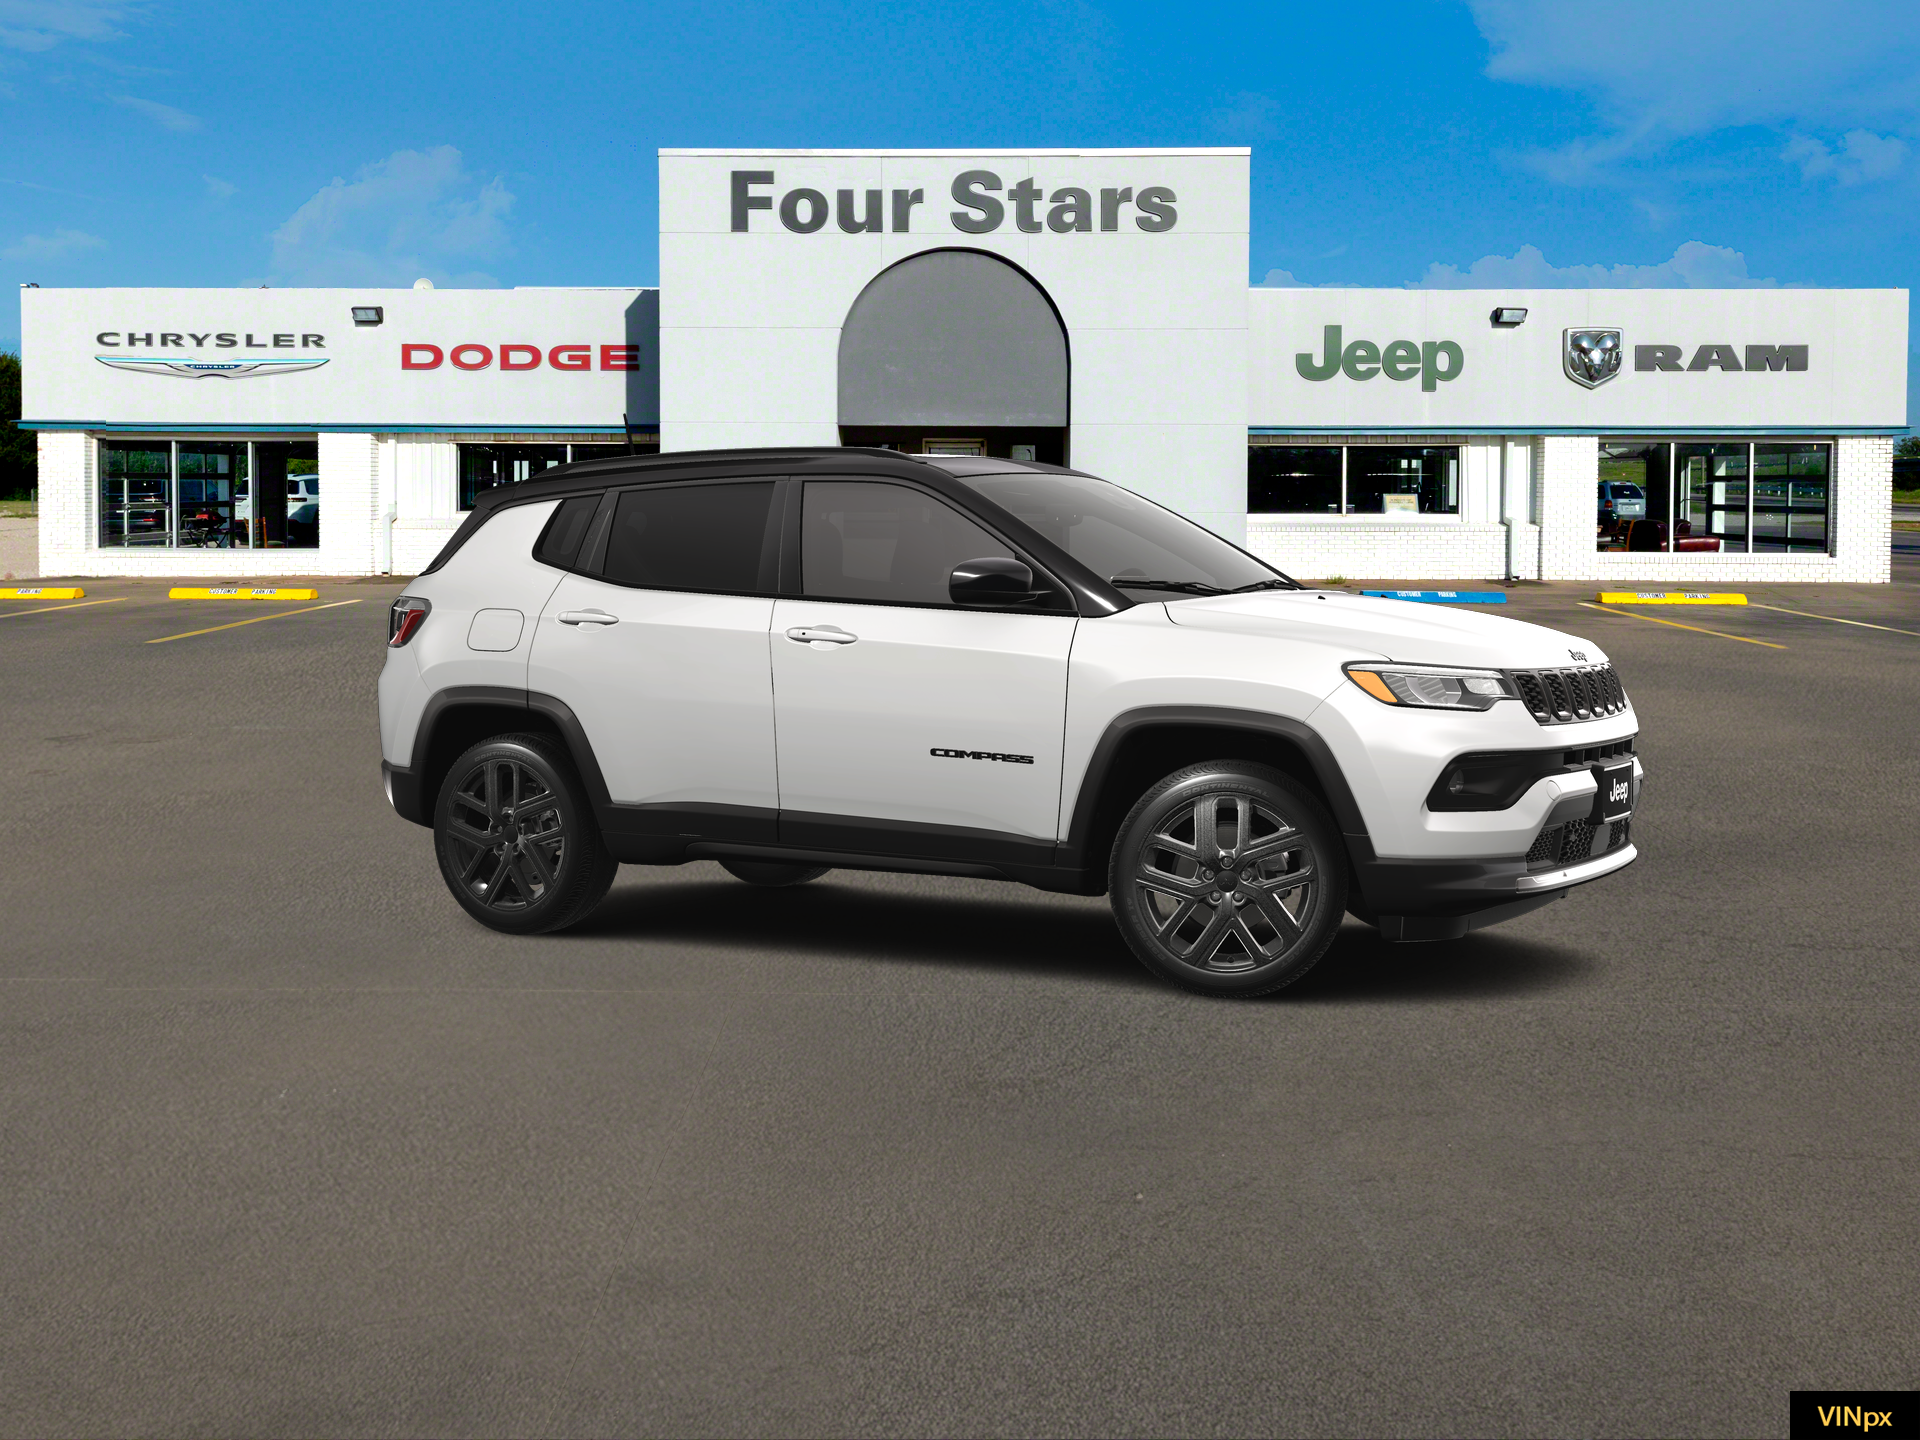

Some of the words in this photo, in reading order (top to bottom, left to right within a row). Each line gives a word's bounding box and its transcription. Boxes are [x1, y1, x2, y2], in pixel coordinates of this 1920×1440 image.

[730, 169, 924, 234] Four
[949, 169, 1179, 234] Stars
[96, 332, 326, 349] CHRYSLER
[401, 343, 640, 371] DODGE
[1295, 324, 1464, 392] Jeep
[1634, 344, 1809, 372] RAM
[1568, 649, 1588, 662] Jeep
[930, 747, 1035, 765] COMPASS
[1182, 782, 1270, 798] CONTINENTAL
[1609, 777, 1629, 804] Jeep
